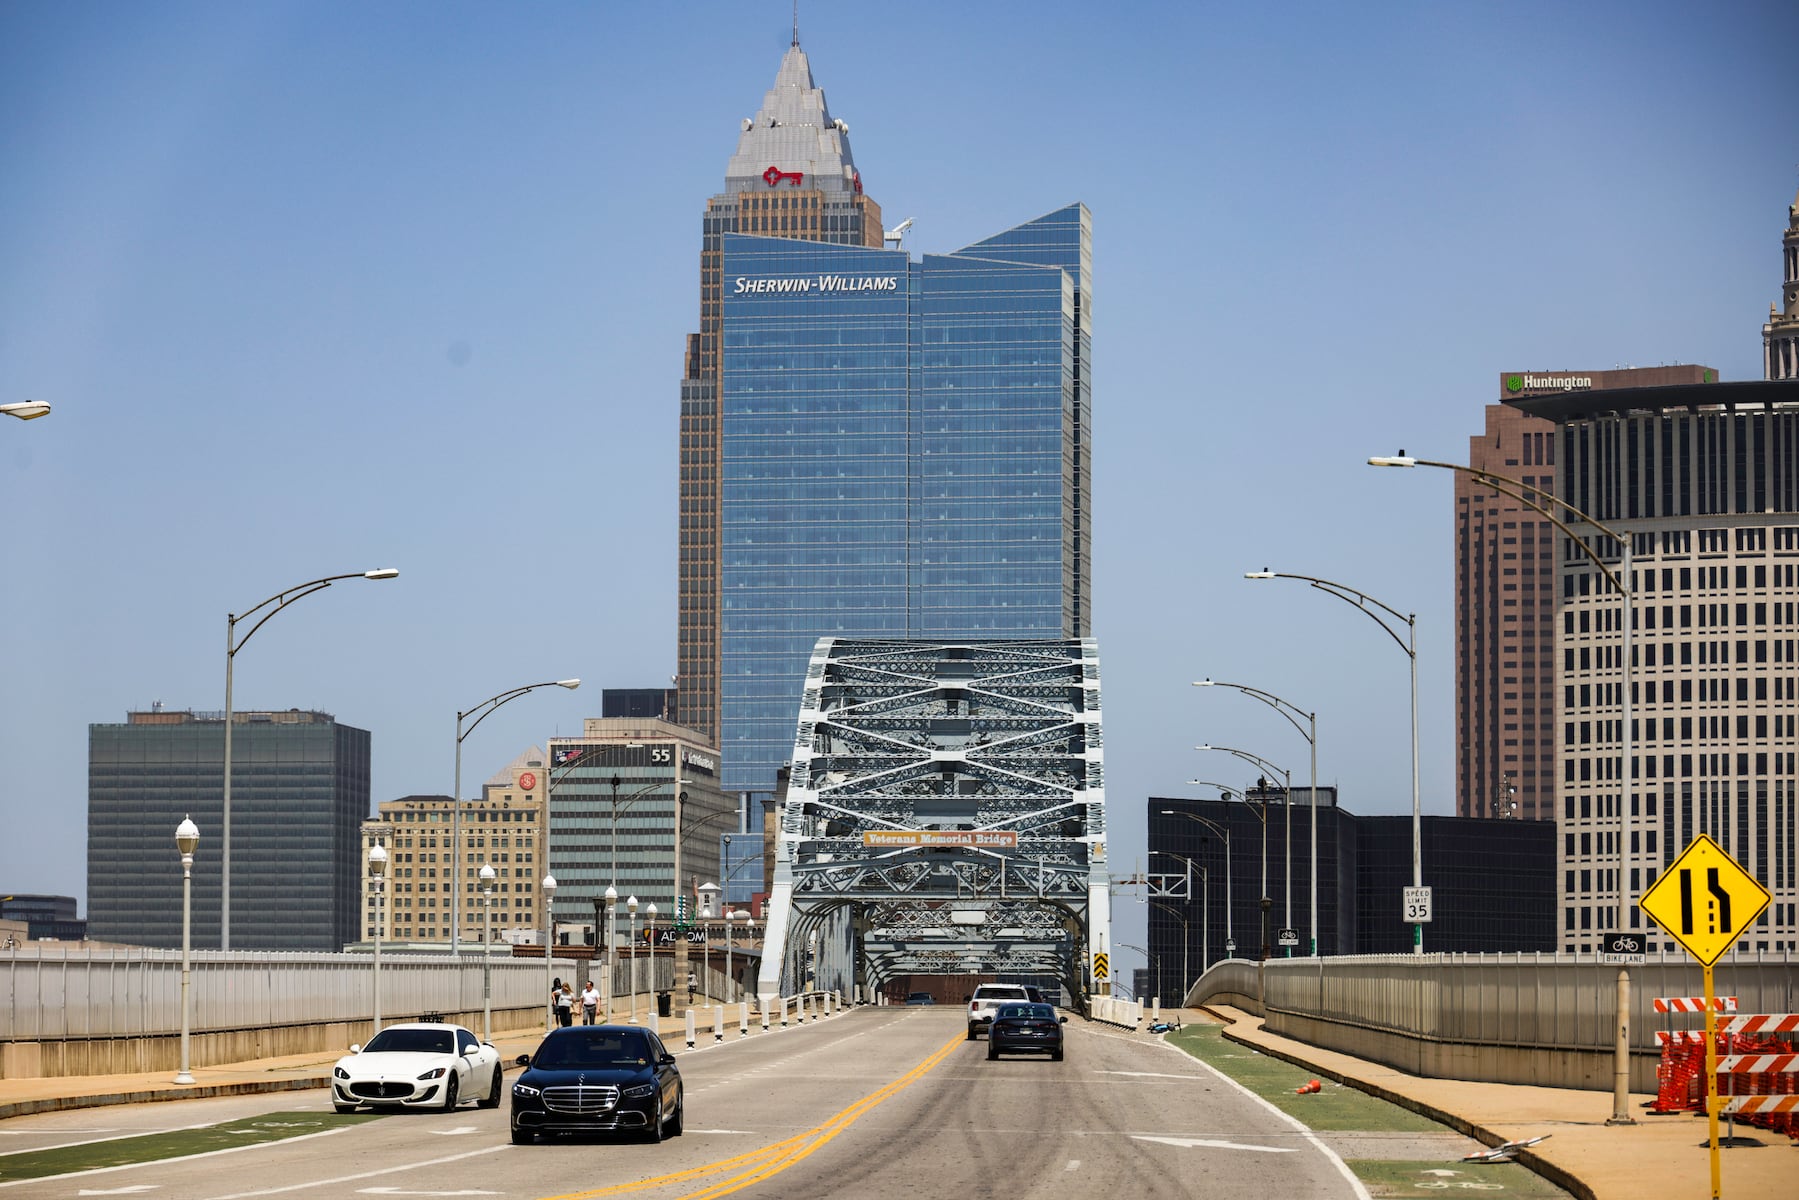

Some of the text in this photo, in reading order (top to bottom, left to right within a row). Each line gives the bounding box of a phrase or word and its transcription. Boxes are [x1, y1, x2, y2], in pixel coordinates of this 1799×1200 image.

[1524, 375, 1592, 391] Huntington
[651, 749, 671, 762] 55
[868, 833, 1013, 846] Veterans Memorial Bridge
[1408, 904, 1427, 918] 35
[660, 931, 705, 942] ADOM
[1606, 954, 1644, 963] BIKE LANE
